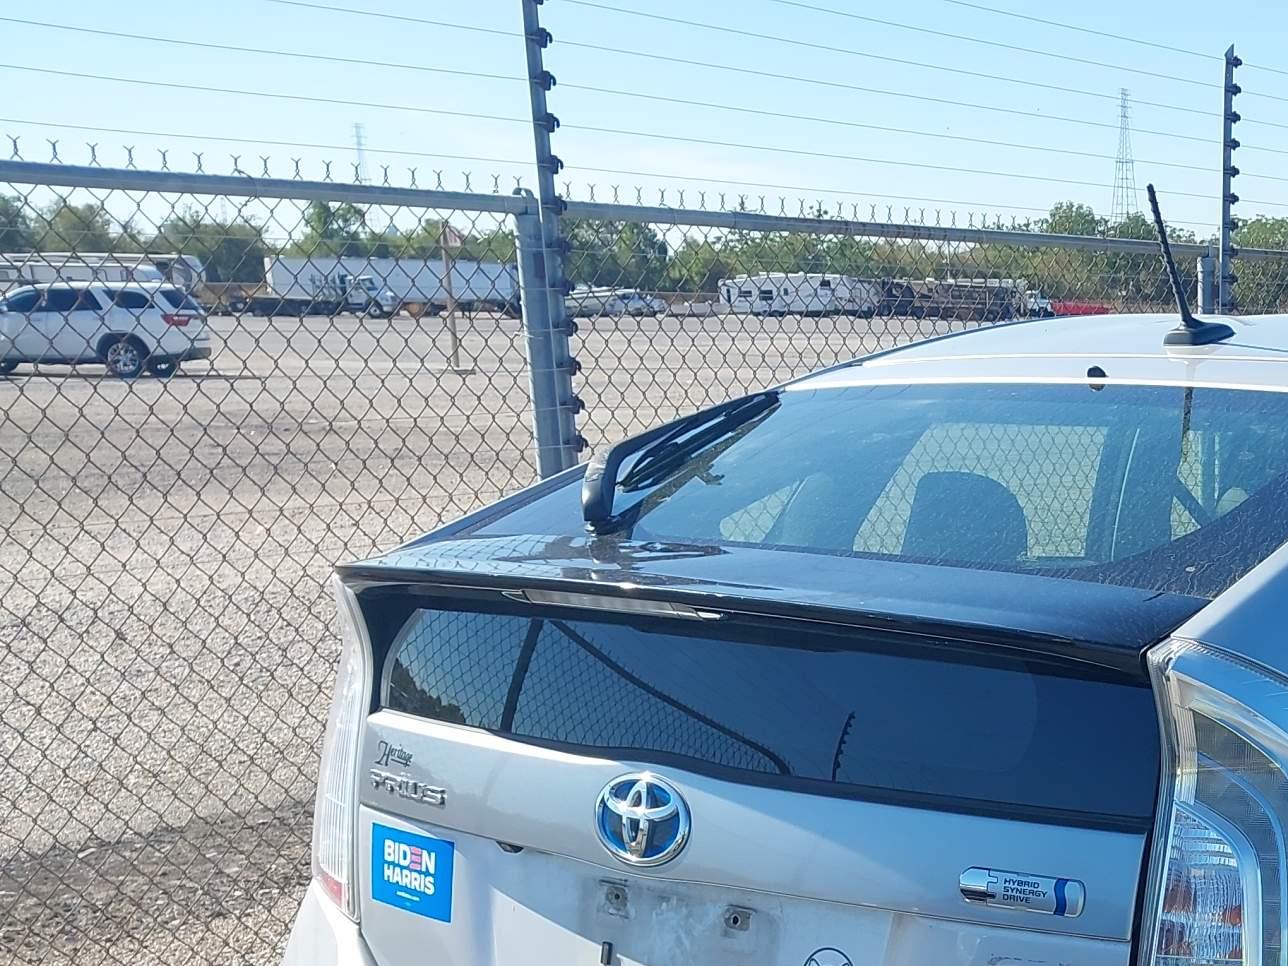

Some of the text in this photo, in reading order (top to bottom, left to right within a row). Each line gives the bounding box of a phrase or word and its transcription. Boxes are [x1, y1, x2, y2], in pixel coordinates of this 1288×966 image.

[369, 768, 447, 806] PRIUS
[384, 839, 436, 874] BIDEN
[383, 864, 435, 896] HARRIS
[1003, 878, 1040, 889] HYBRID
[1002, 894, 1031, 904] DRIVE
[1003, 886, 1048, 899] SYNERGY
